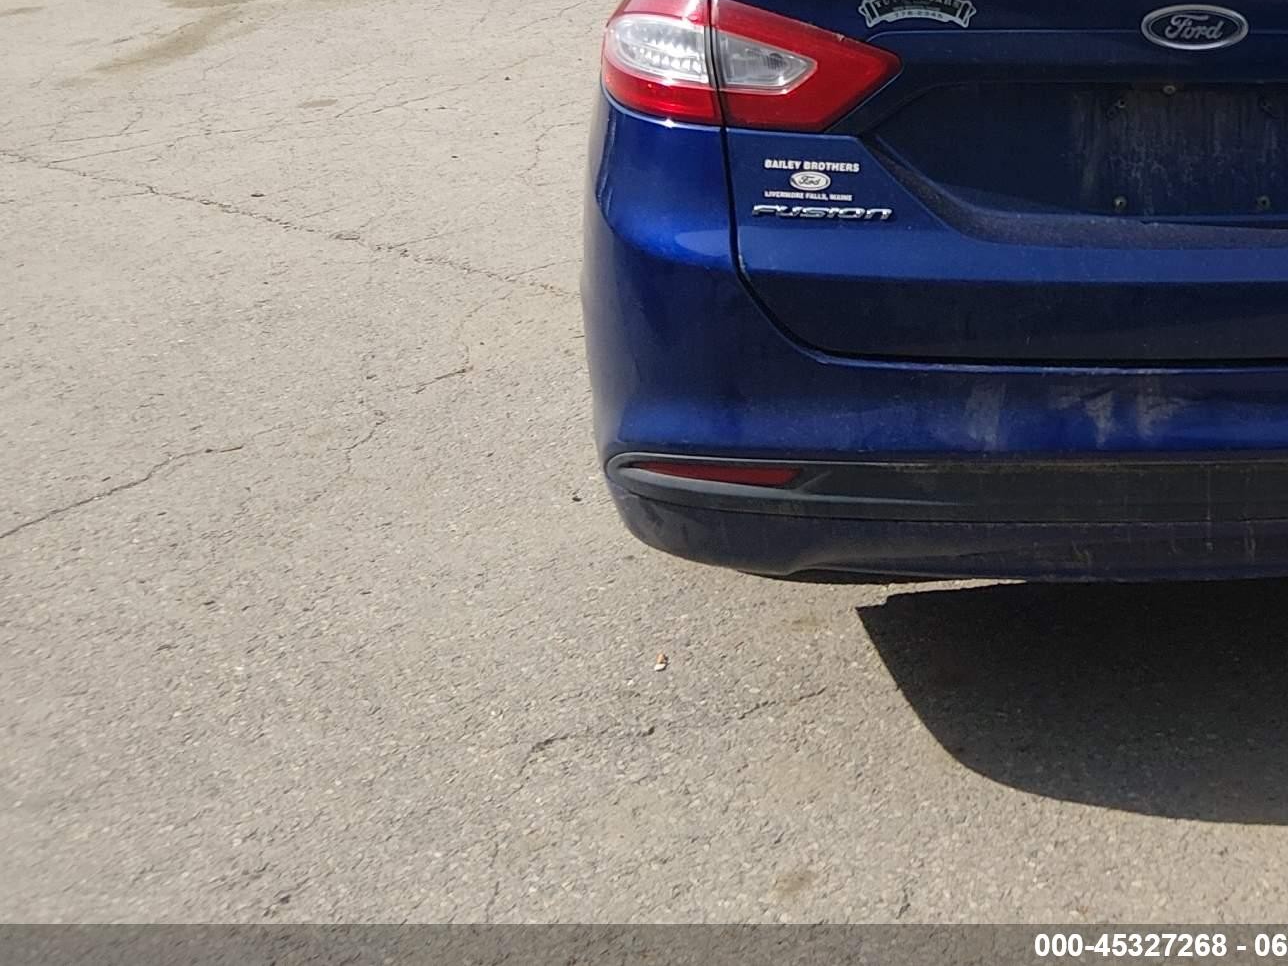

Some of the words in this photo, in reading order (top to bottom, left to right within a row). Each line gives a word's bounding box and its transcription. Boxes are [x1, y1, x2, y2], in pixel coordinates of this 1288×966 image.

[1164, 14, 1224, 40] Ford
[764, 158, 802, 170] BAILEY
[803, 160, 860, 172] BROTHERS
[798, 175, 822, 186] Ford
